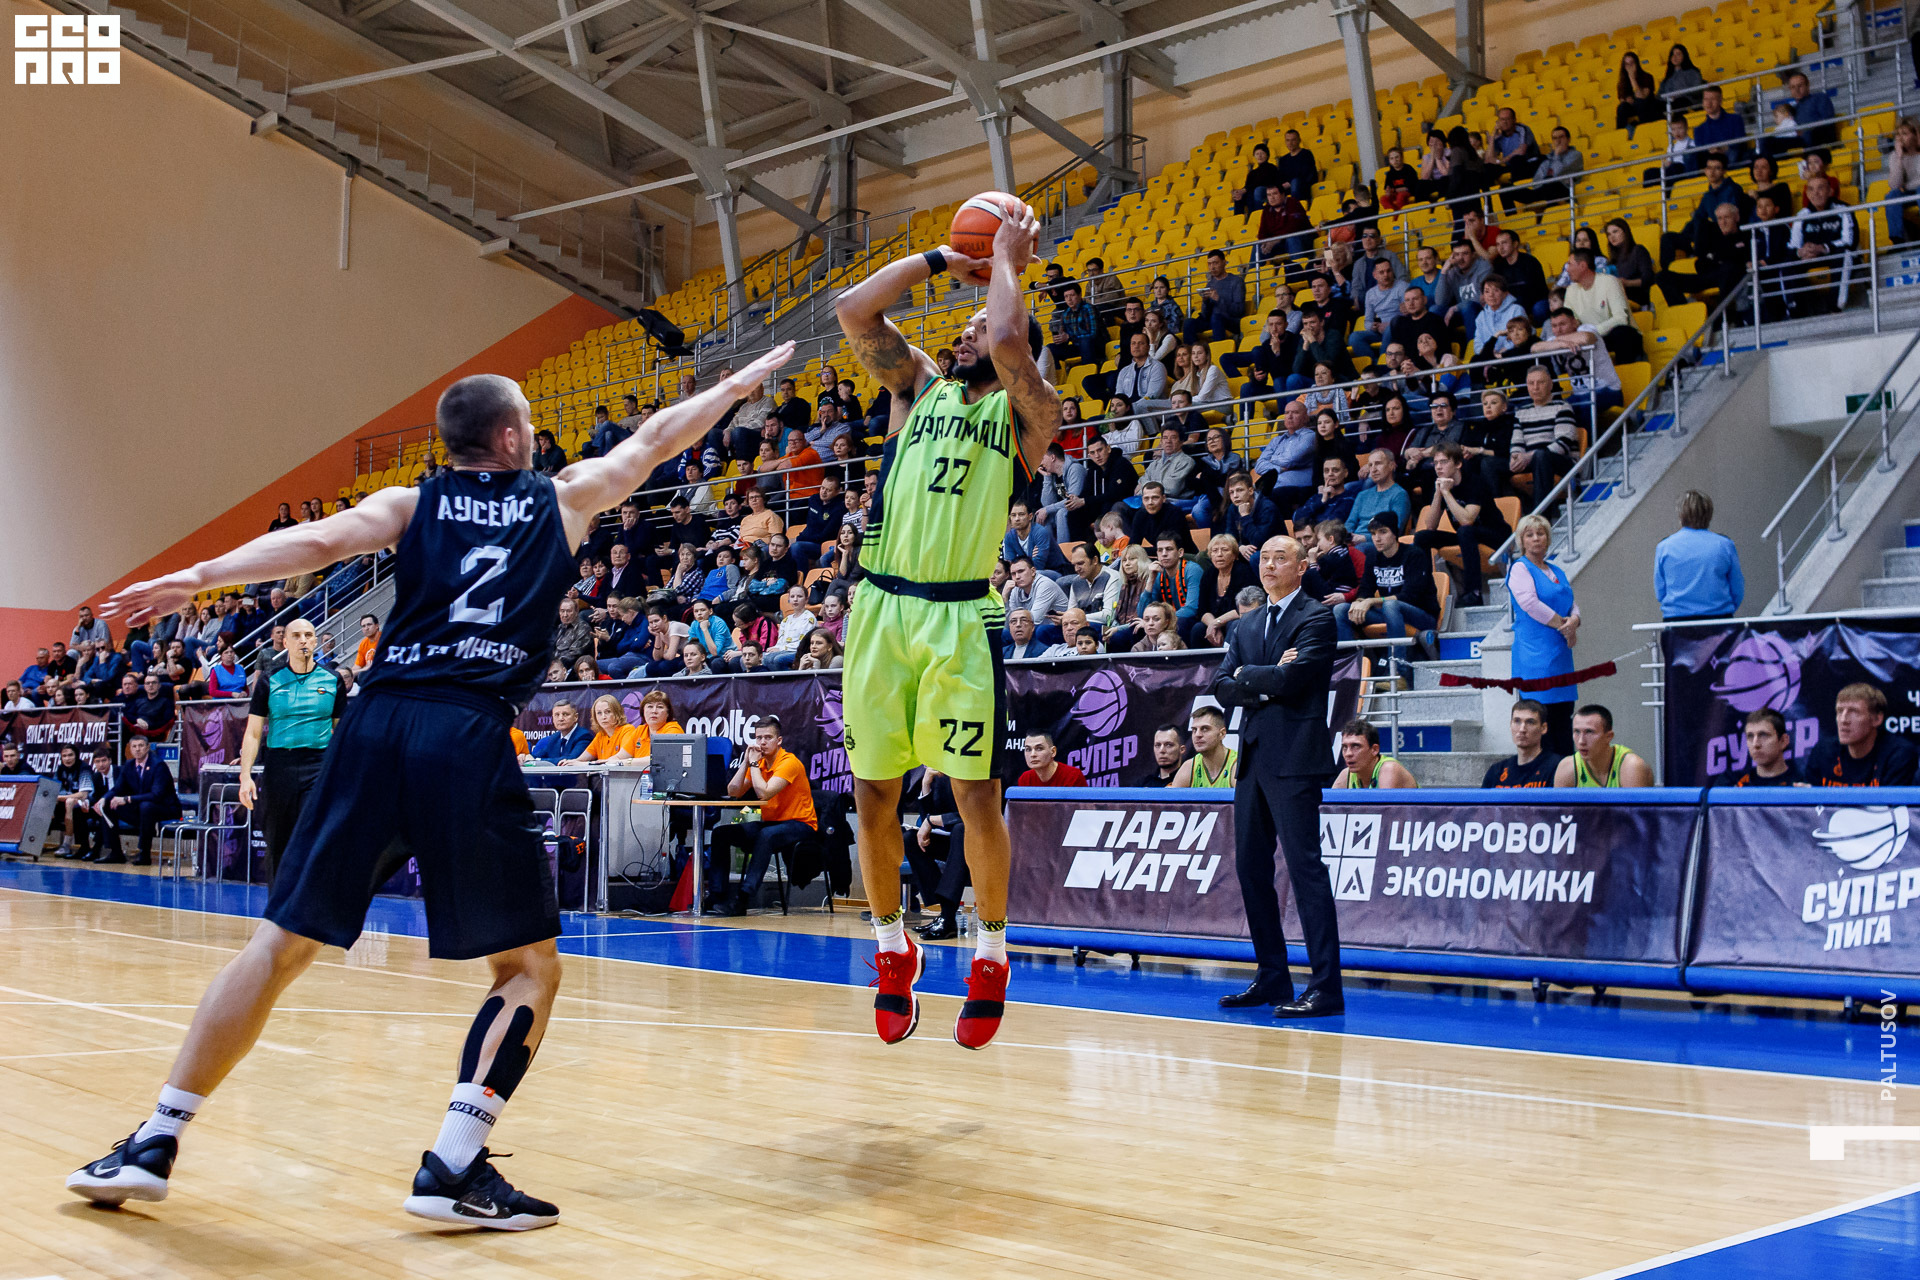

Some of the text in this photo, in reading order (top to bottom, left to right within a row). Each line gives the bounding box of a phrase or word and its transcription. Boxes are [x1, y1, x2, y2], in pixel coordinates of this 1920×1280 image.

[908, 414, 1011, 459] УРАЛМАШ
[927, 457, 972, 496] 22
[437, 494, 534, 527] АУСЕЙС
[448, 545, 512, 626] 2
[84, 721, 107, 745] ДЛЯ
[939, 718, 985, 757] 22
[1062, 810, 1219, 850] ПАРИ
[1388, 815, 1577, 857] ЦИФРОВОЙ
[1063, 851, 1221, 894] МАТЧ
[1383, 866, 1595, 903] ЭКОНОМИКИ
[1802, 867, 1920, 923] СУПЕР
[1824, 915, 1891, 951] ЛИГА
[450, 1102, 479, 1116] JUST
